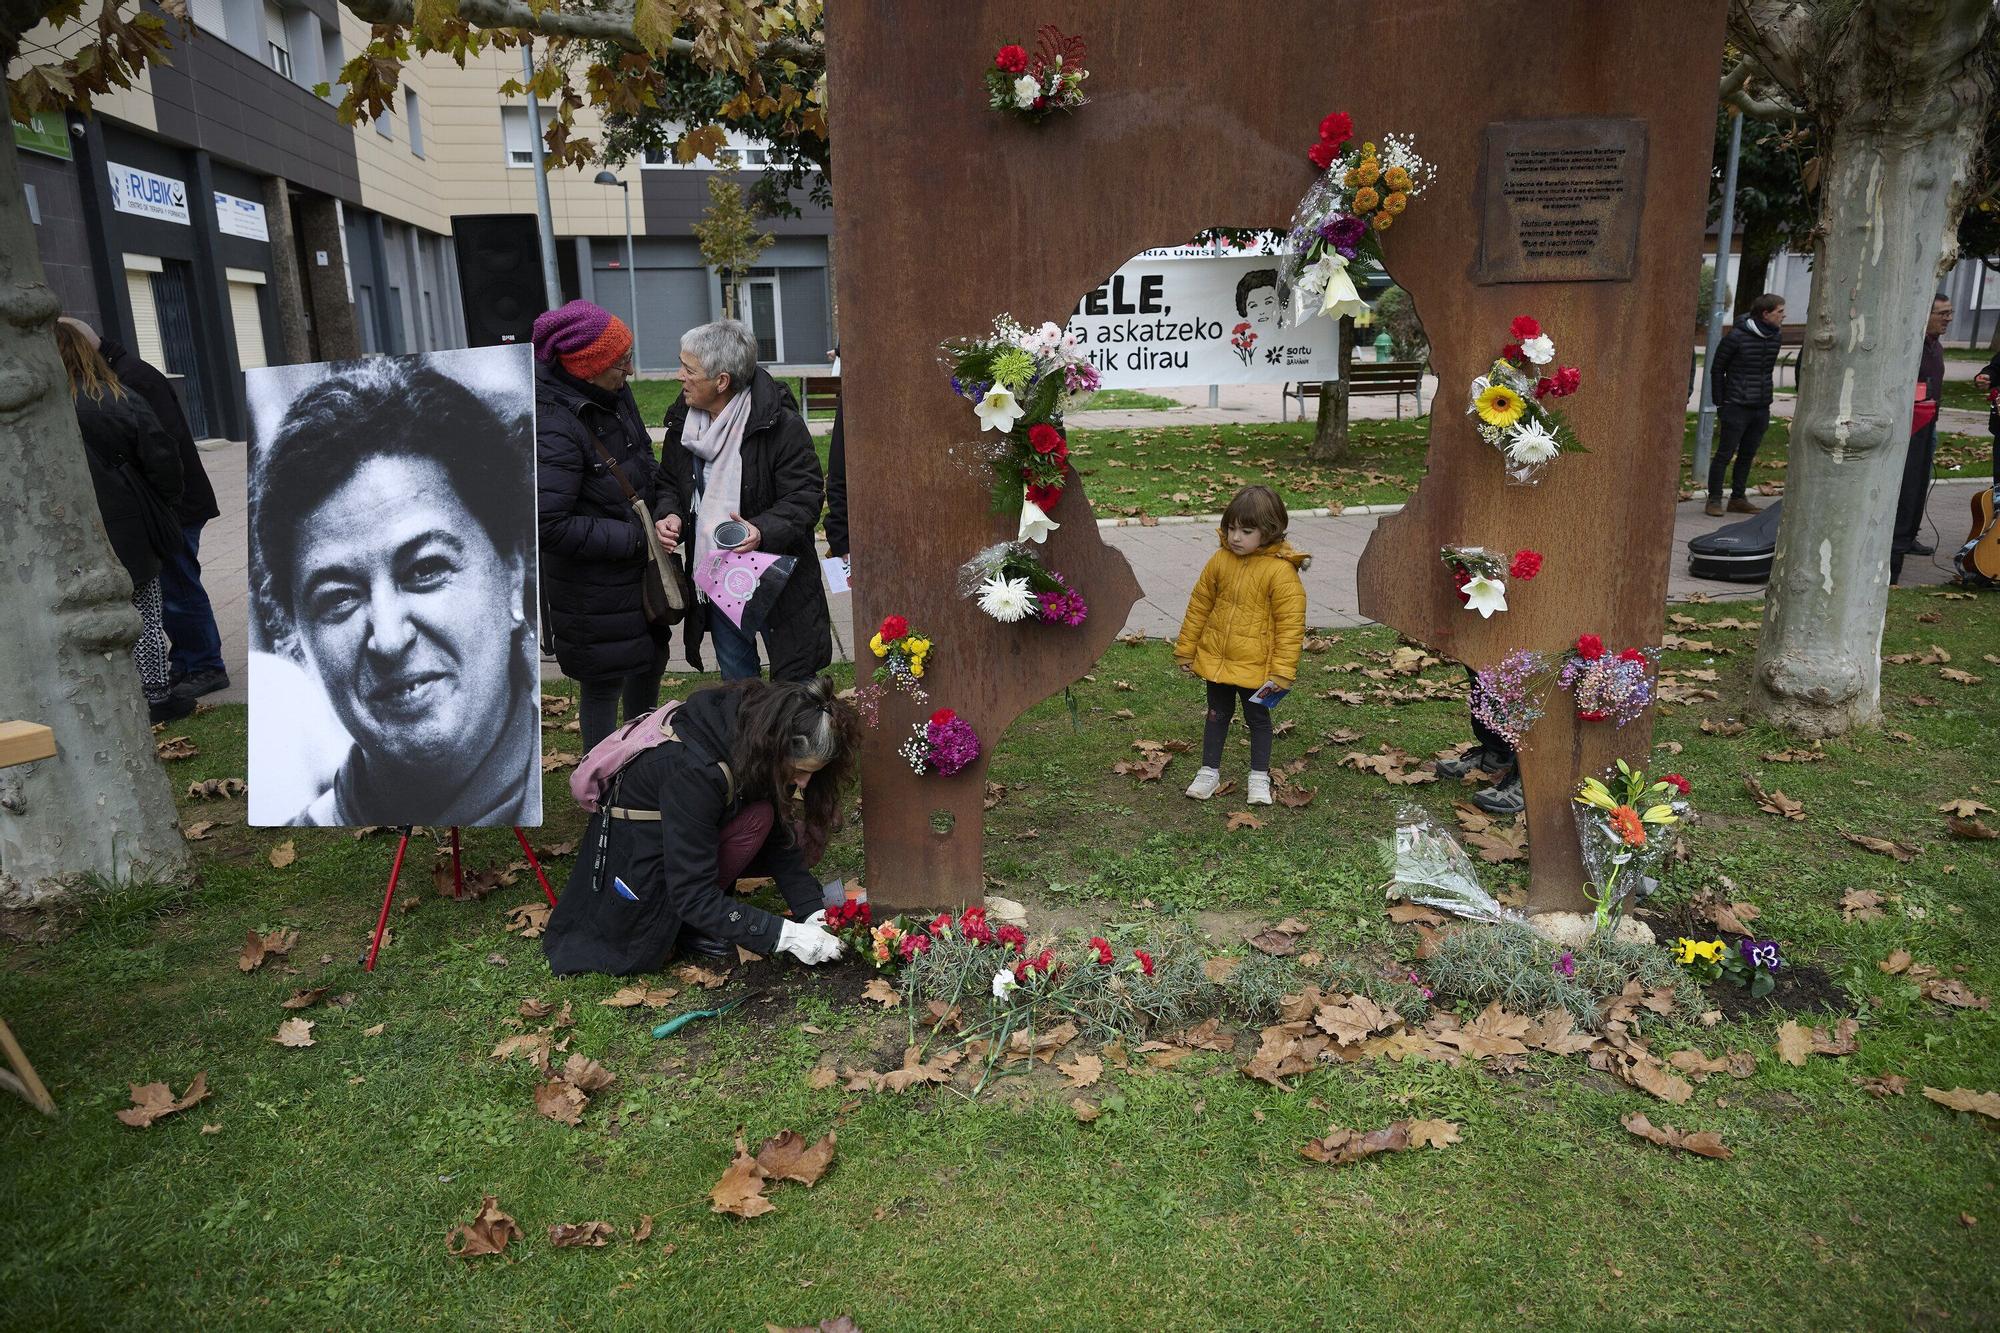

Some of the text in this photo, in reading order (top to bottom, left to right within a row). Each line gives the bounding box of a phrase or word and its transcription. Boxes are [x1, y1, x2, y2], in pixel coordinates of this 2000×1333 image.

[130, 174, 174, 207] RUBIK
[1072, 274, 1171, 317] ELE,
[1097, 317, 1223, 343] askatzeko
[1127, 346, 1189, 371] dirau
[1286, 346, 1312, 356] sortu
